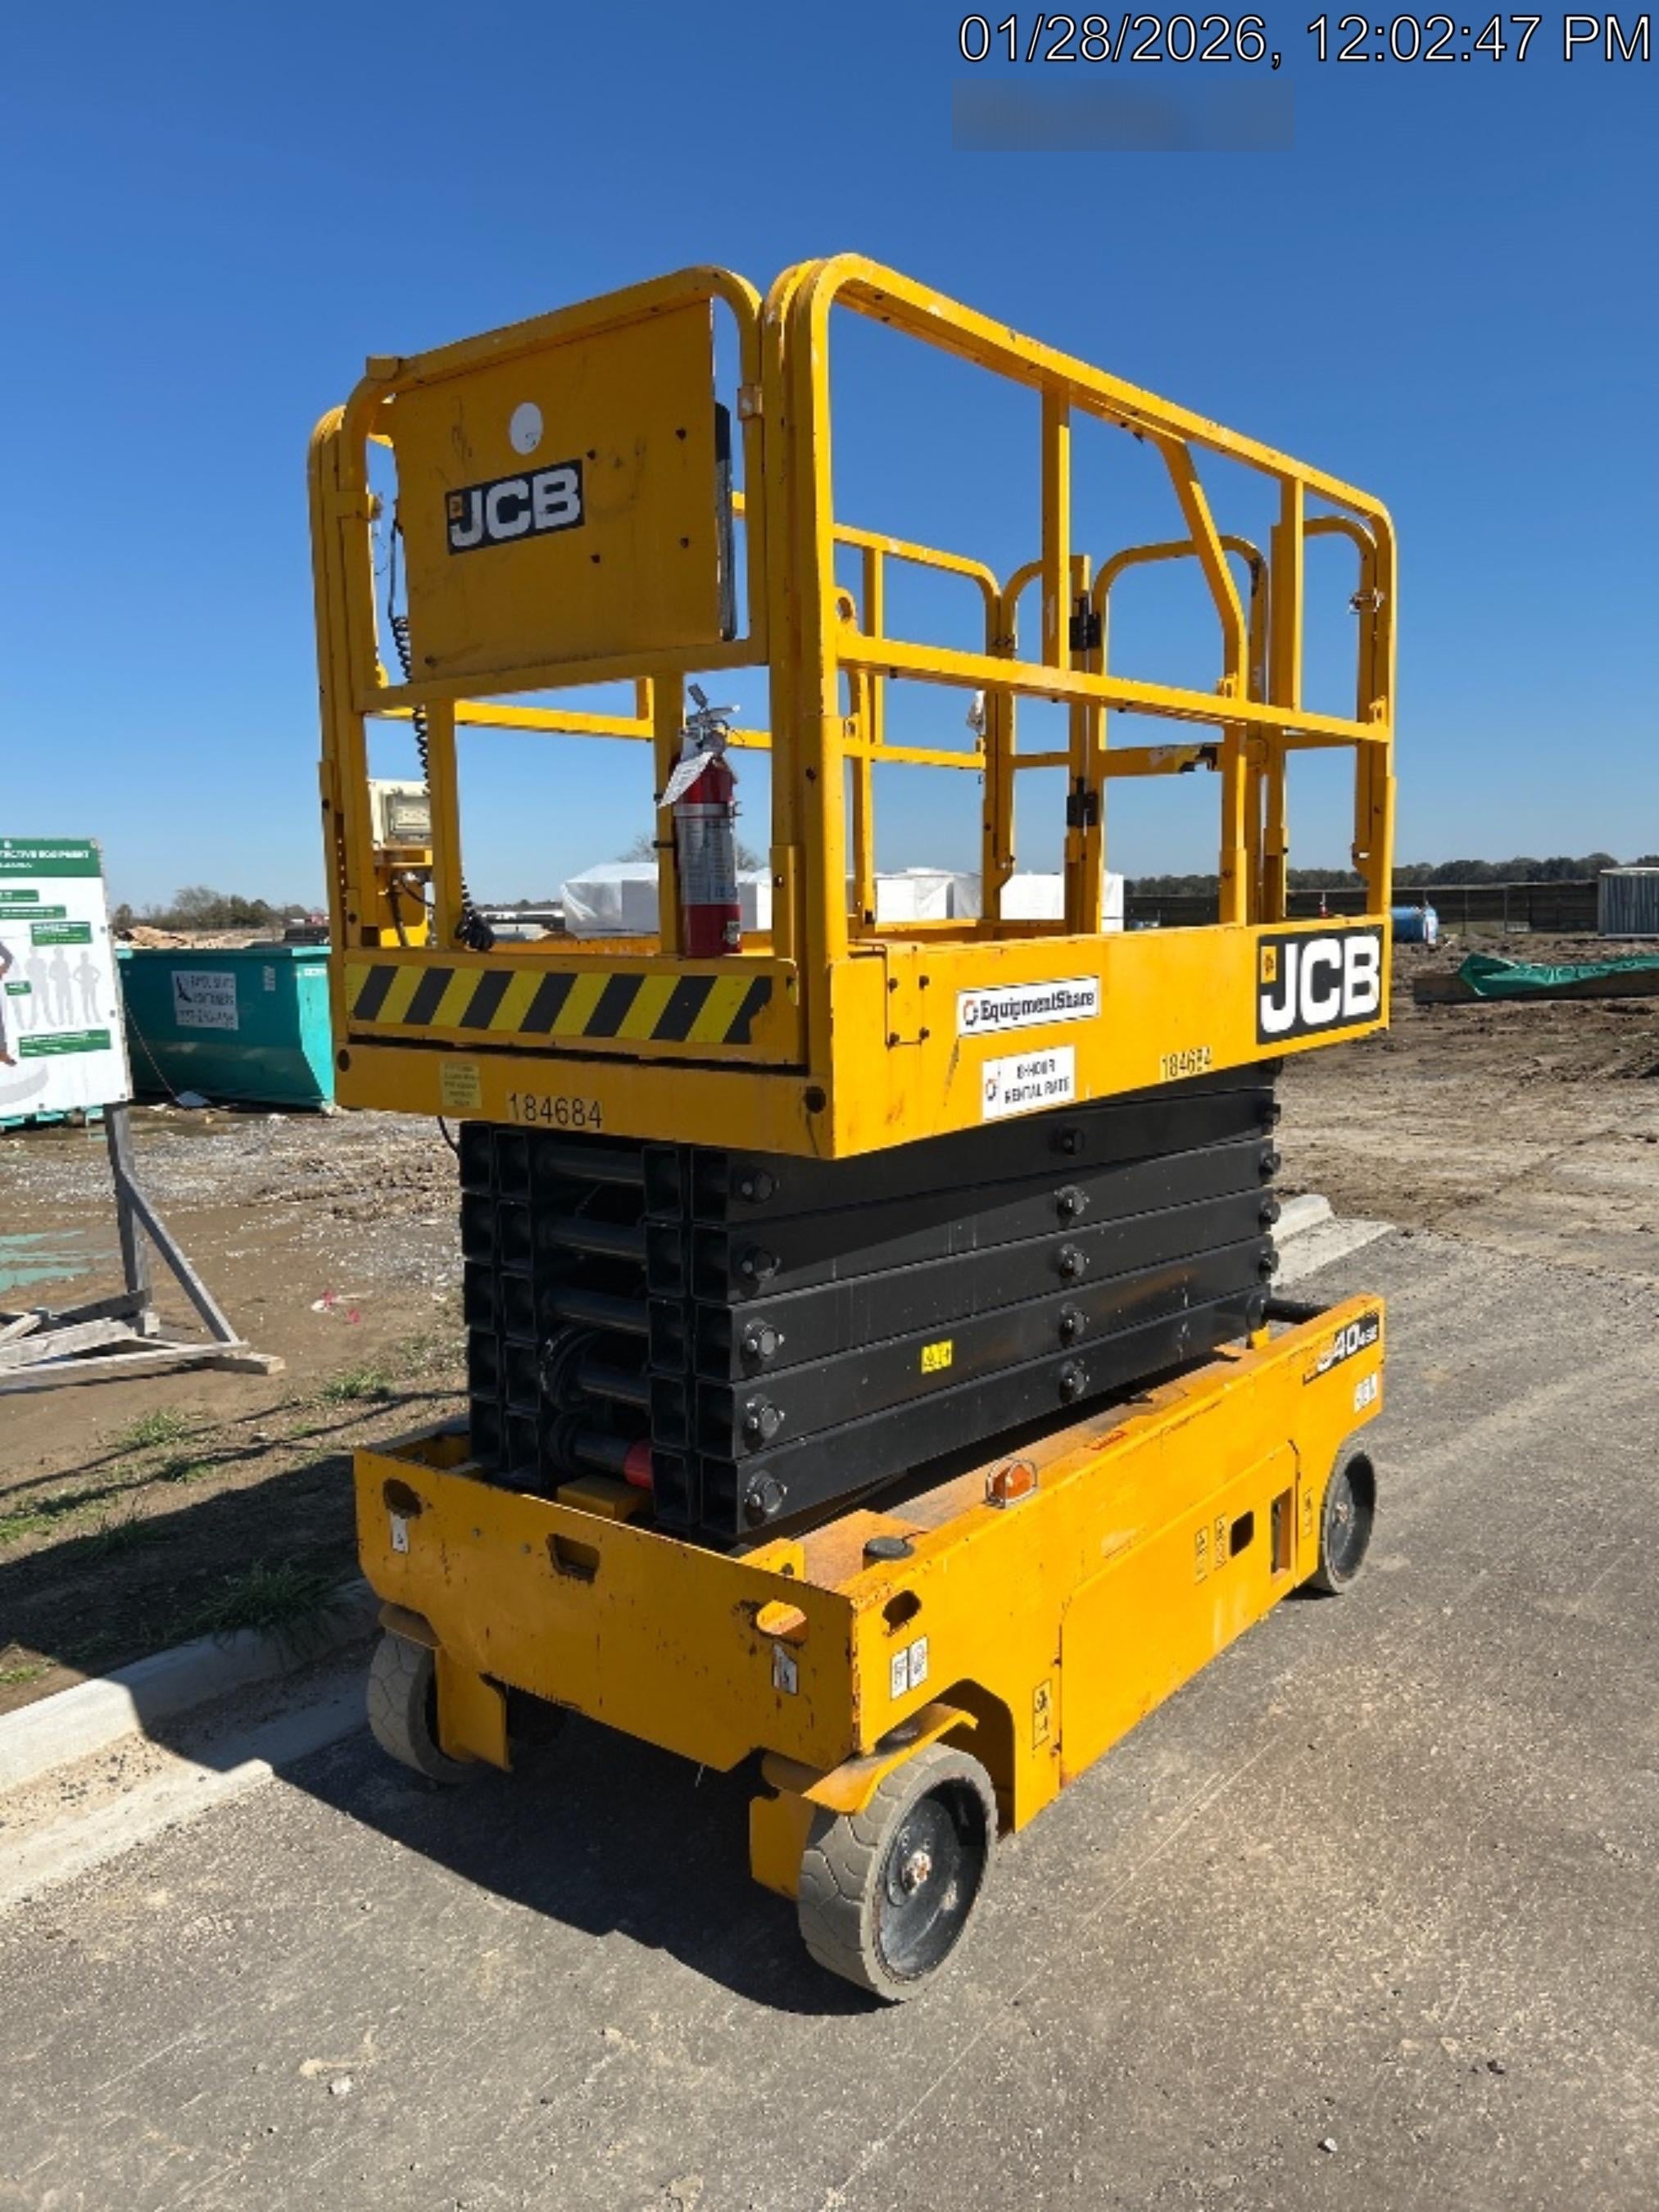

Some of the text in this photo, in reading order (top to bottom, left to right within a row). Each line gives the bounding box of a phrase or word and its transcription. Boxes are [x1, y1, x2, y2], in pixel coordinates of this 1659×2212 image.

[451, 466, 582, 547] JCB
[1260, 935, 1381, 1034] JCB
[981, 990, 1095, 1022] EquipmentShare
[1162, 1046, 1213, 1080] 184684
[1004, 1077, 1069, 1104] RENTAL RATE
[508, 1091, 603, 1129] 184684
